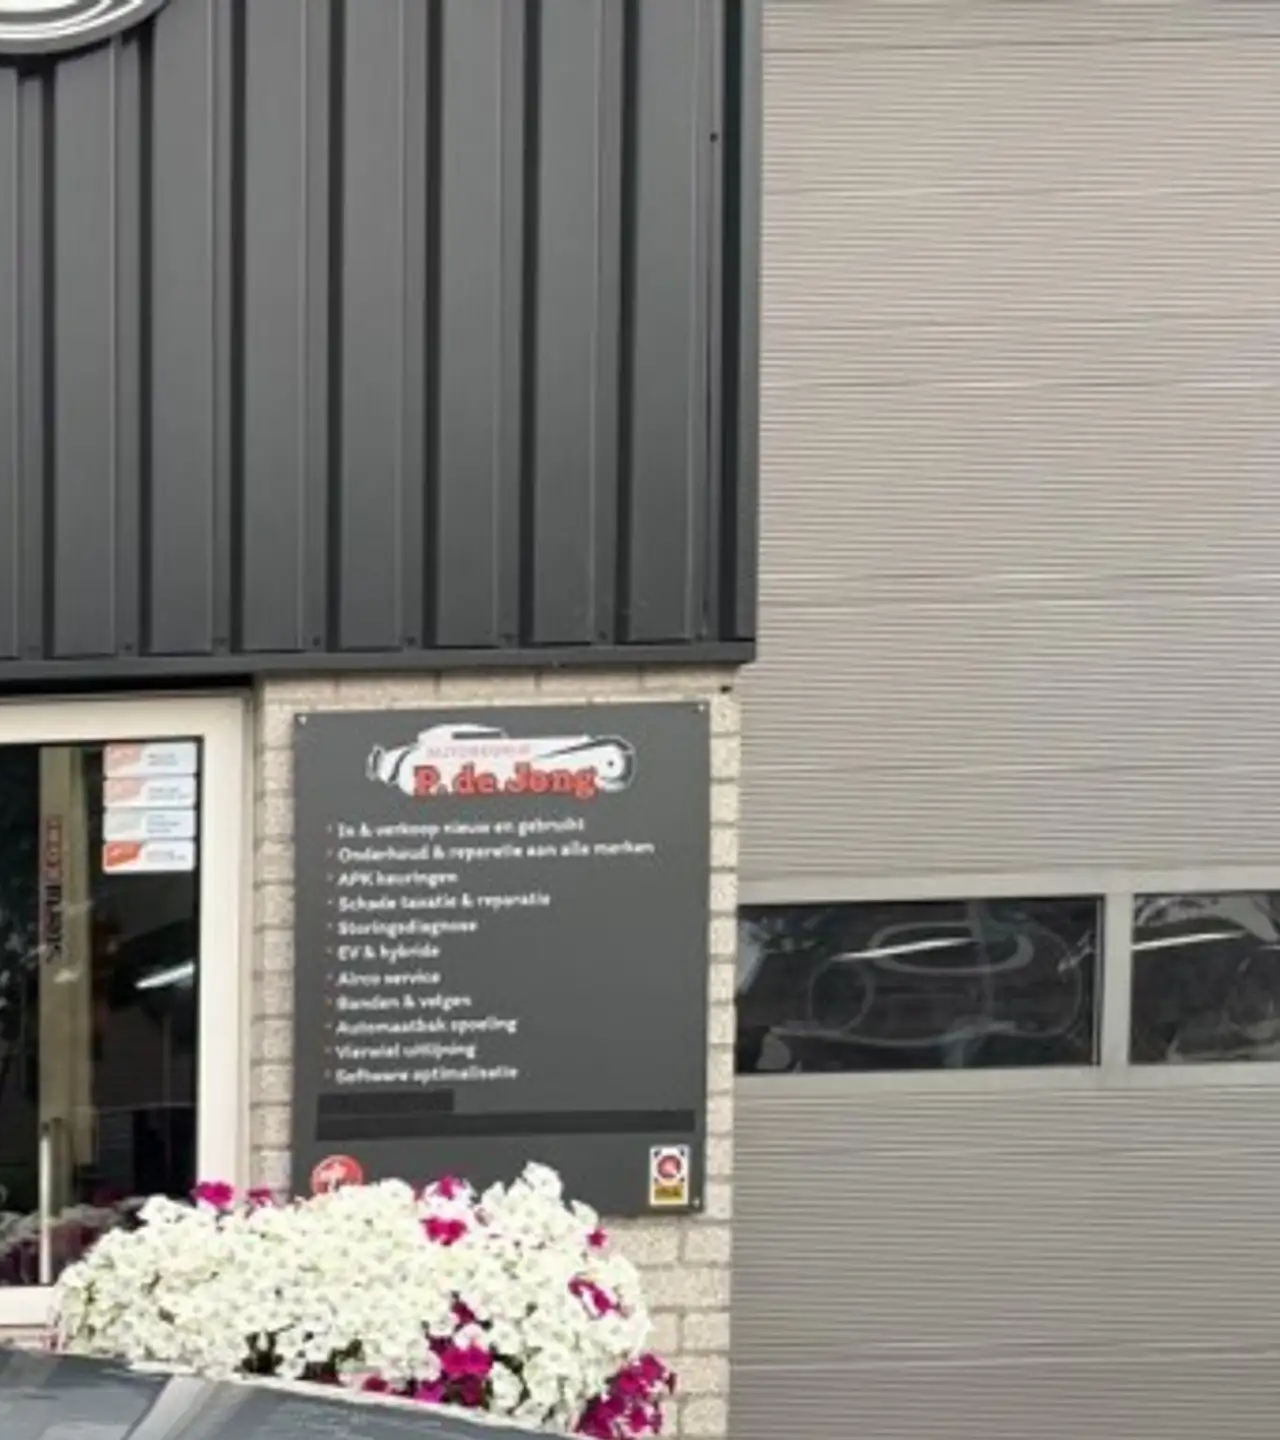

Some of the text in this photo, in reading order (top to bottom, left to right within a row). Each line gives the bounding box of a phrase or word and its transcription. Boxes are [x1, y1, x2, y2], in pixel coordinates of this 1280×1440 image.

[413, 762, 597, 799] P. de Jong
[338, 871, 373, 886] APK
[336, 995, 400, 1010] Banden
[419, 993, 471, 1011] velgen
[451, 1015, 518, 1035] spoeling
[336, 1068, 409, 1084] Software
